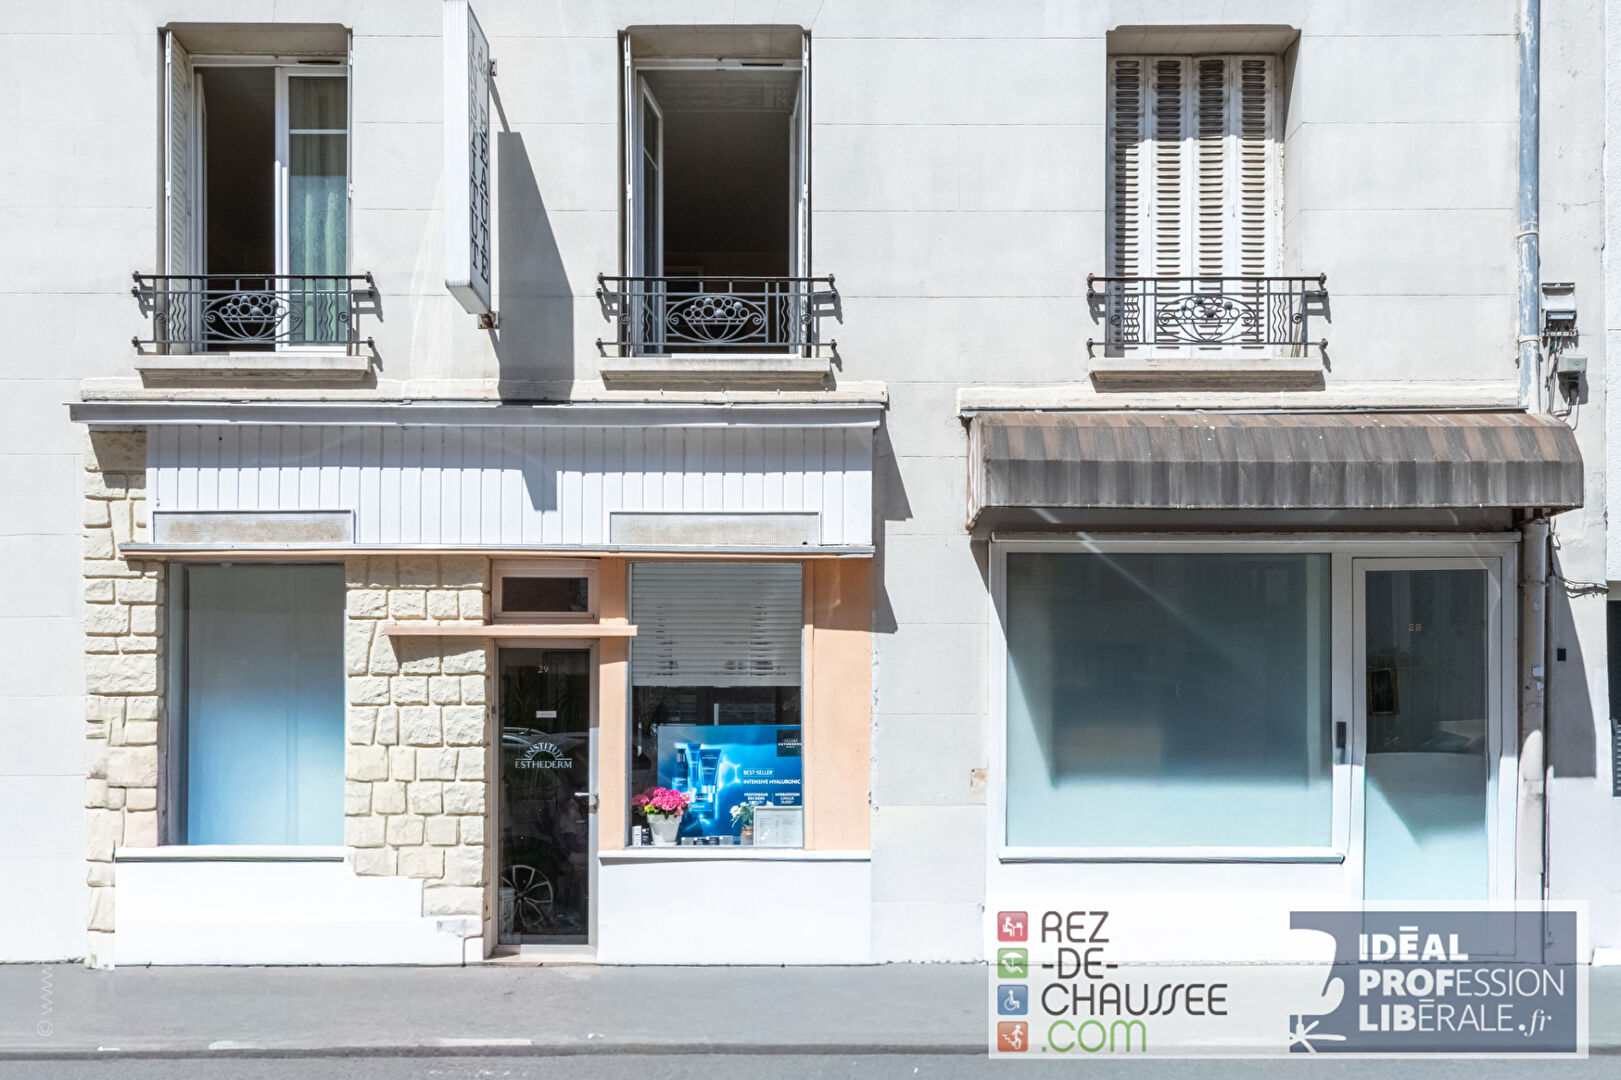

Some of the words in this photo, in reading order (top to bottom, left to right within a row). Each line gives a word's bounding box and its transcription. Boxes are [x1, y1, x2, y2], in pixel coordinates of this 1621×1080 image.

[537, 665, 549, 674] 29
[524, 742, 564, 759] INSTITUT
[515, 760, 573, 769] ESTHEDERM
